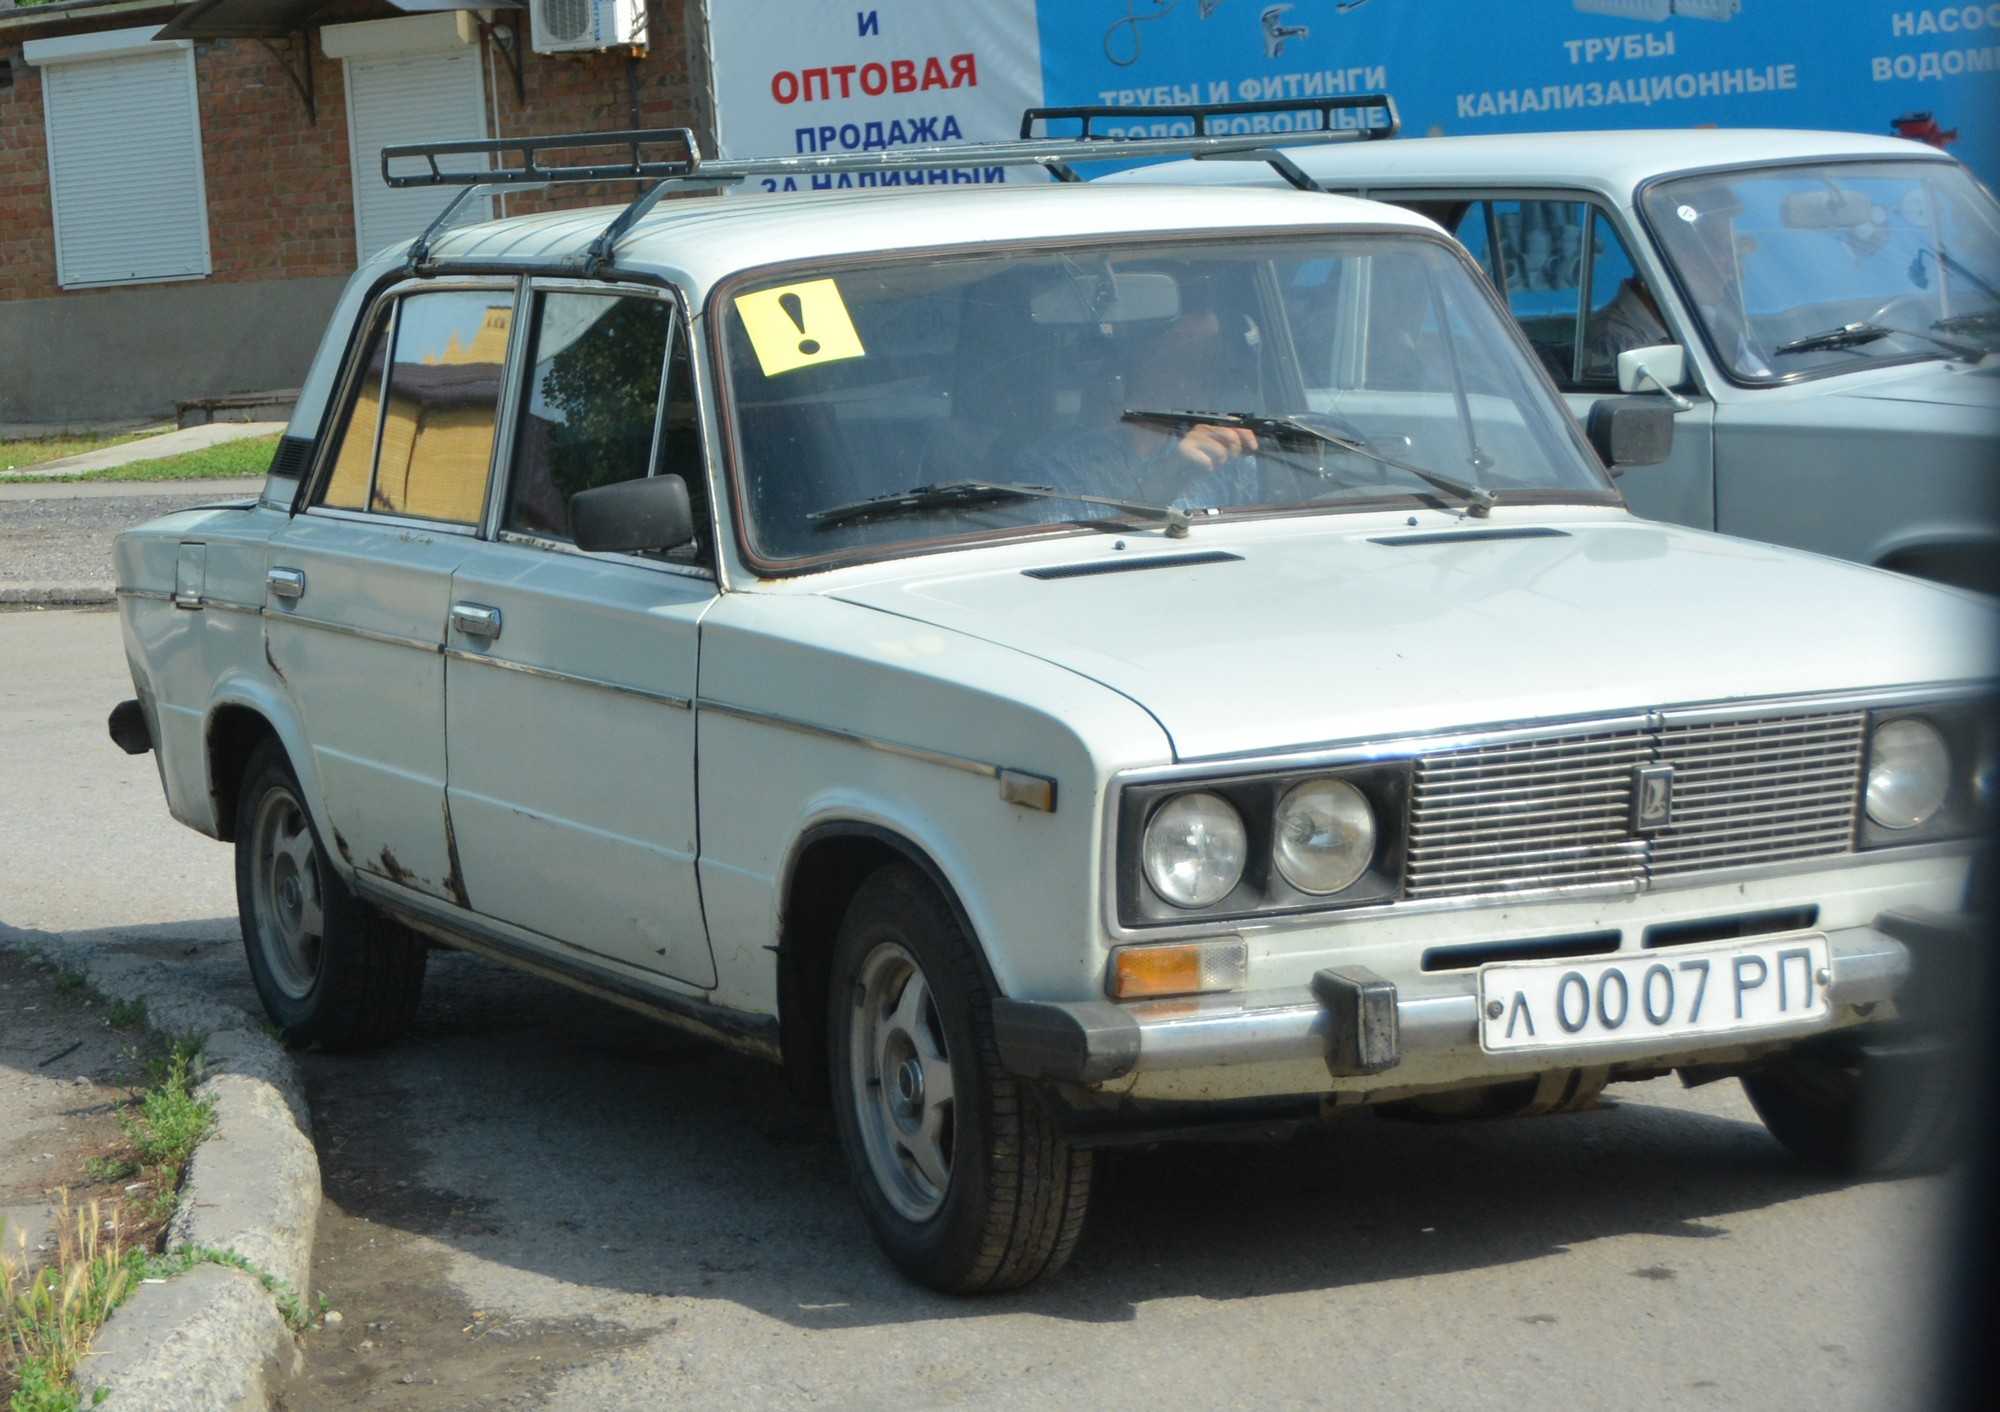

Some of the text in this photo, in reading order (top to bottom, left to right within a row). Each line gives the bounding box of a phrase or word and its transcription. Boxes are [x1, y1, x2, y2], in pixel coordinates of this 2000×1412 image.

[857, 10, 879, 37] И
[1563, 31, 1675, 64] ТРУБЫ
[1871, 46, 2000, 82] ВОДОМ
[771, 53, 978, 105] ОПТОВАЯ
[1099, 65, 1387, 106] ТРУБЫ И ФИТИНГИ
[1457, 64, 1798, 119] КАНАЛИЗАЦИОННЫЕ
[795, 114, 962, 153] ПРОДАЖА
[1732, 947, 1813, 1020] РП
